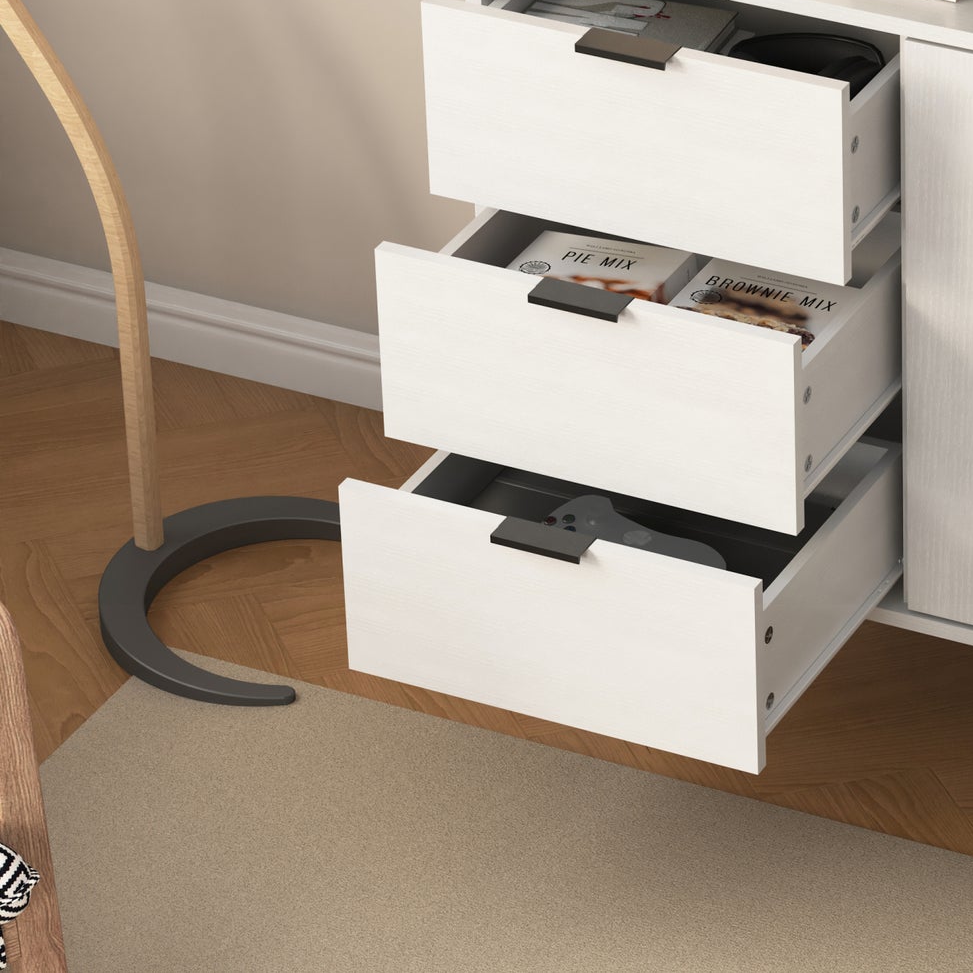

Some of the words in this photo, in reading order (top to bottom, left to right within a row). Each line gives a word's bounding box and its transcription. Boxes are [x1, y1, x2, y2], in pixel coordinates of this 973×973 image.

[561, 250, 594, 265] PIE
[599, 256, 639, 271] MIX
[705, 275, 796, 303] BROWNIE
[799, 295, 838, 312] MIX
